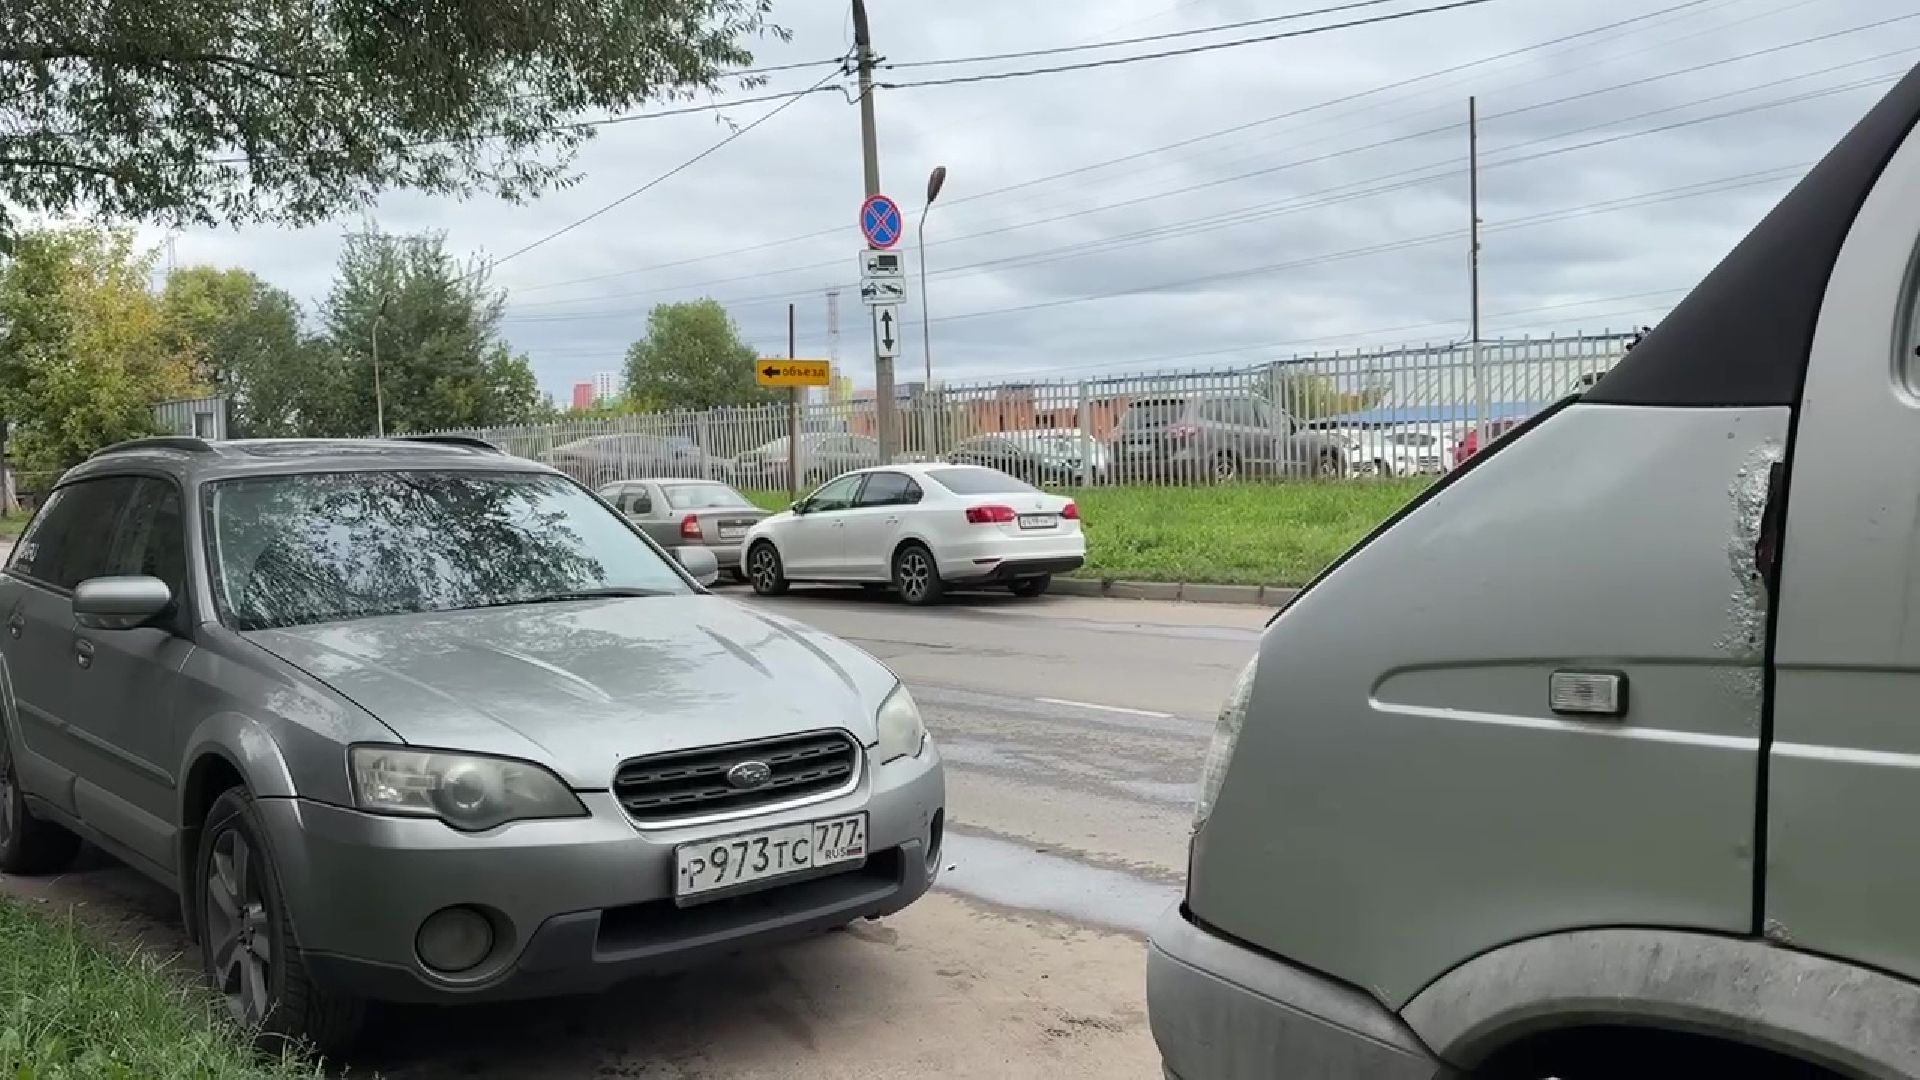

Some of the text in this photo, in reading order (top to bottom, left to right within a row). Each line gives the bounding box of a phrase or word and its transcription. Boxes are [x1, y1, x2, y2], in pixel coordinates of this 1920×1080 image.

[783, 366, 825, 377] объезд
[688, 819, 859, 889] Р973ТС 777
[825, 847, 847, 859] RUS
